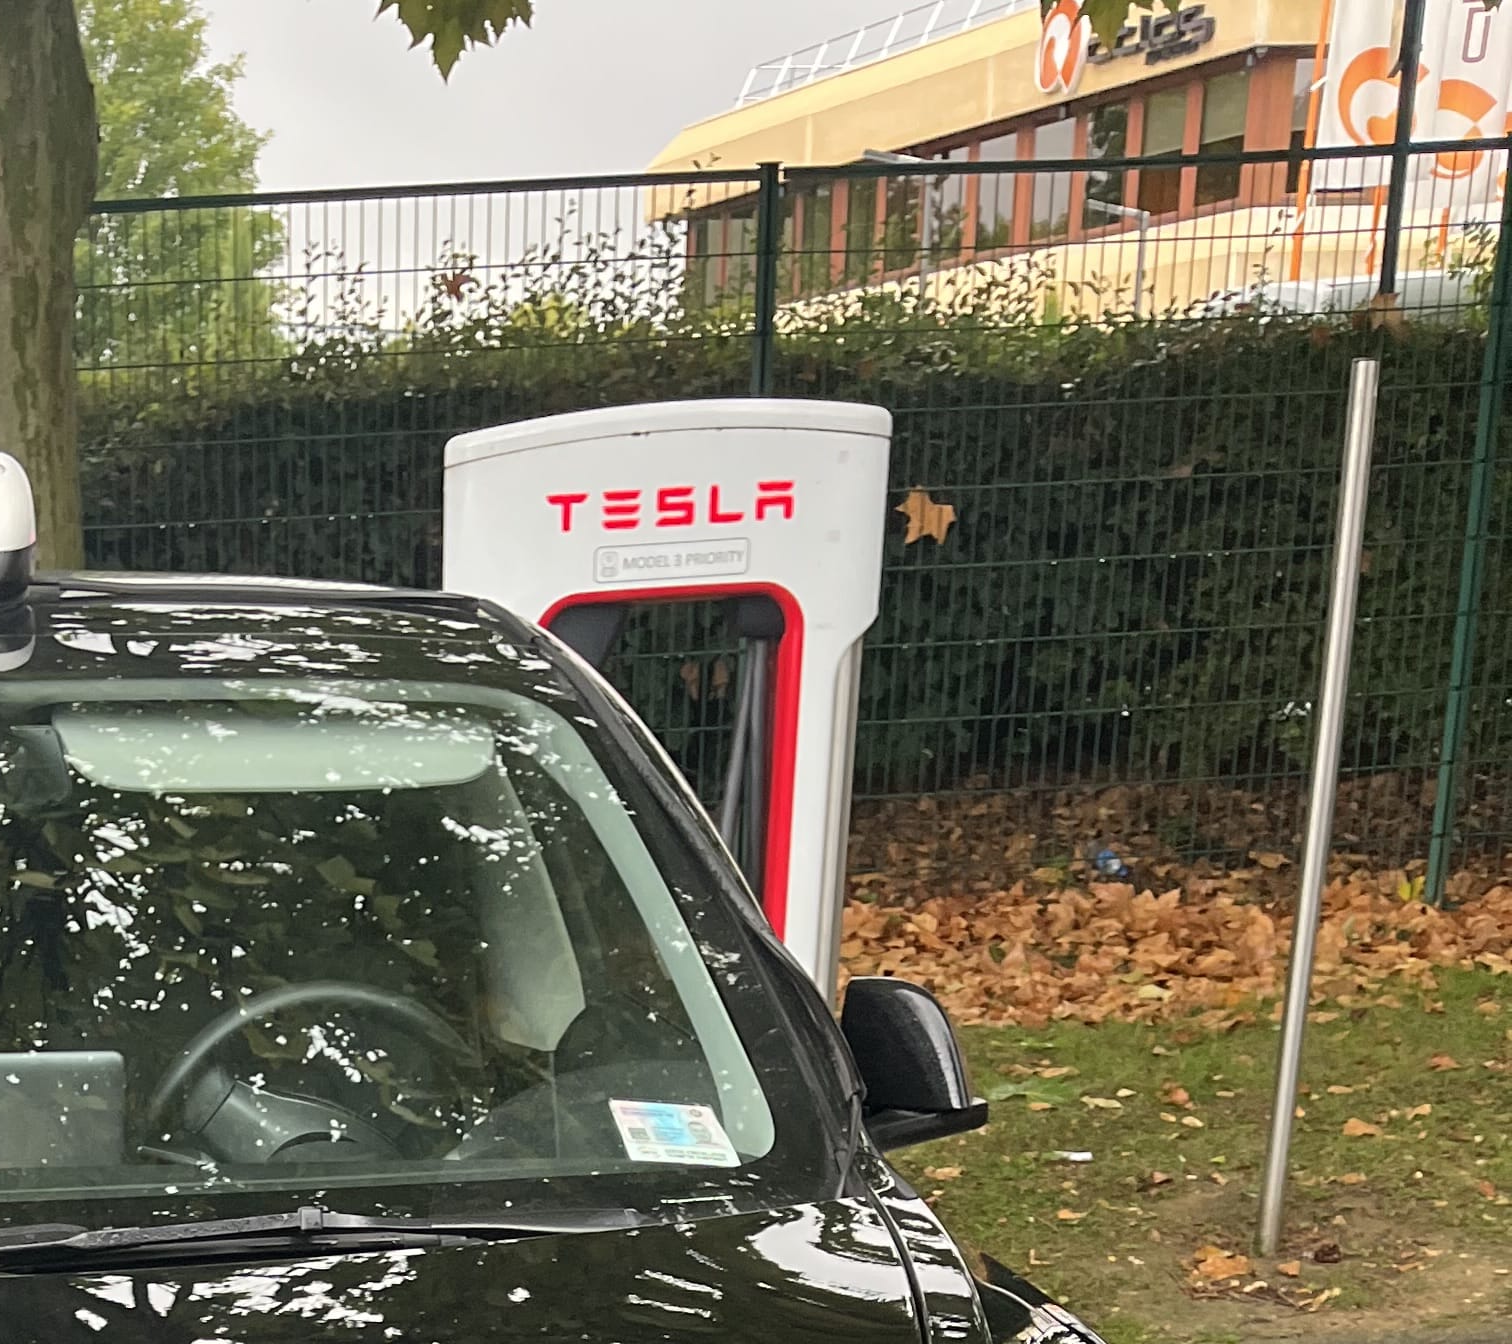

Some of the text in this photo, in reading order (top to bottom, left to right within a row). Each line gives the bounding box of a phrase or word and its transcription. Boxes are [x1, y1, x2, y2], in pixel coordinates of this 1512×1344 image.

[545, 479, 796, 534] TESLA
[621, 554, 671, 571] MODEL
[685, 549, 745, 567] PRIORITY
